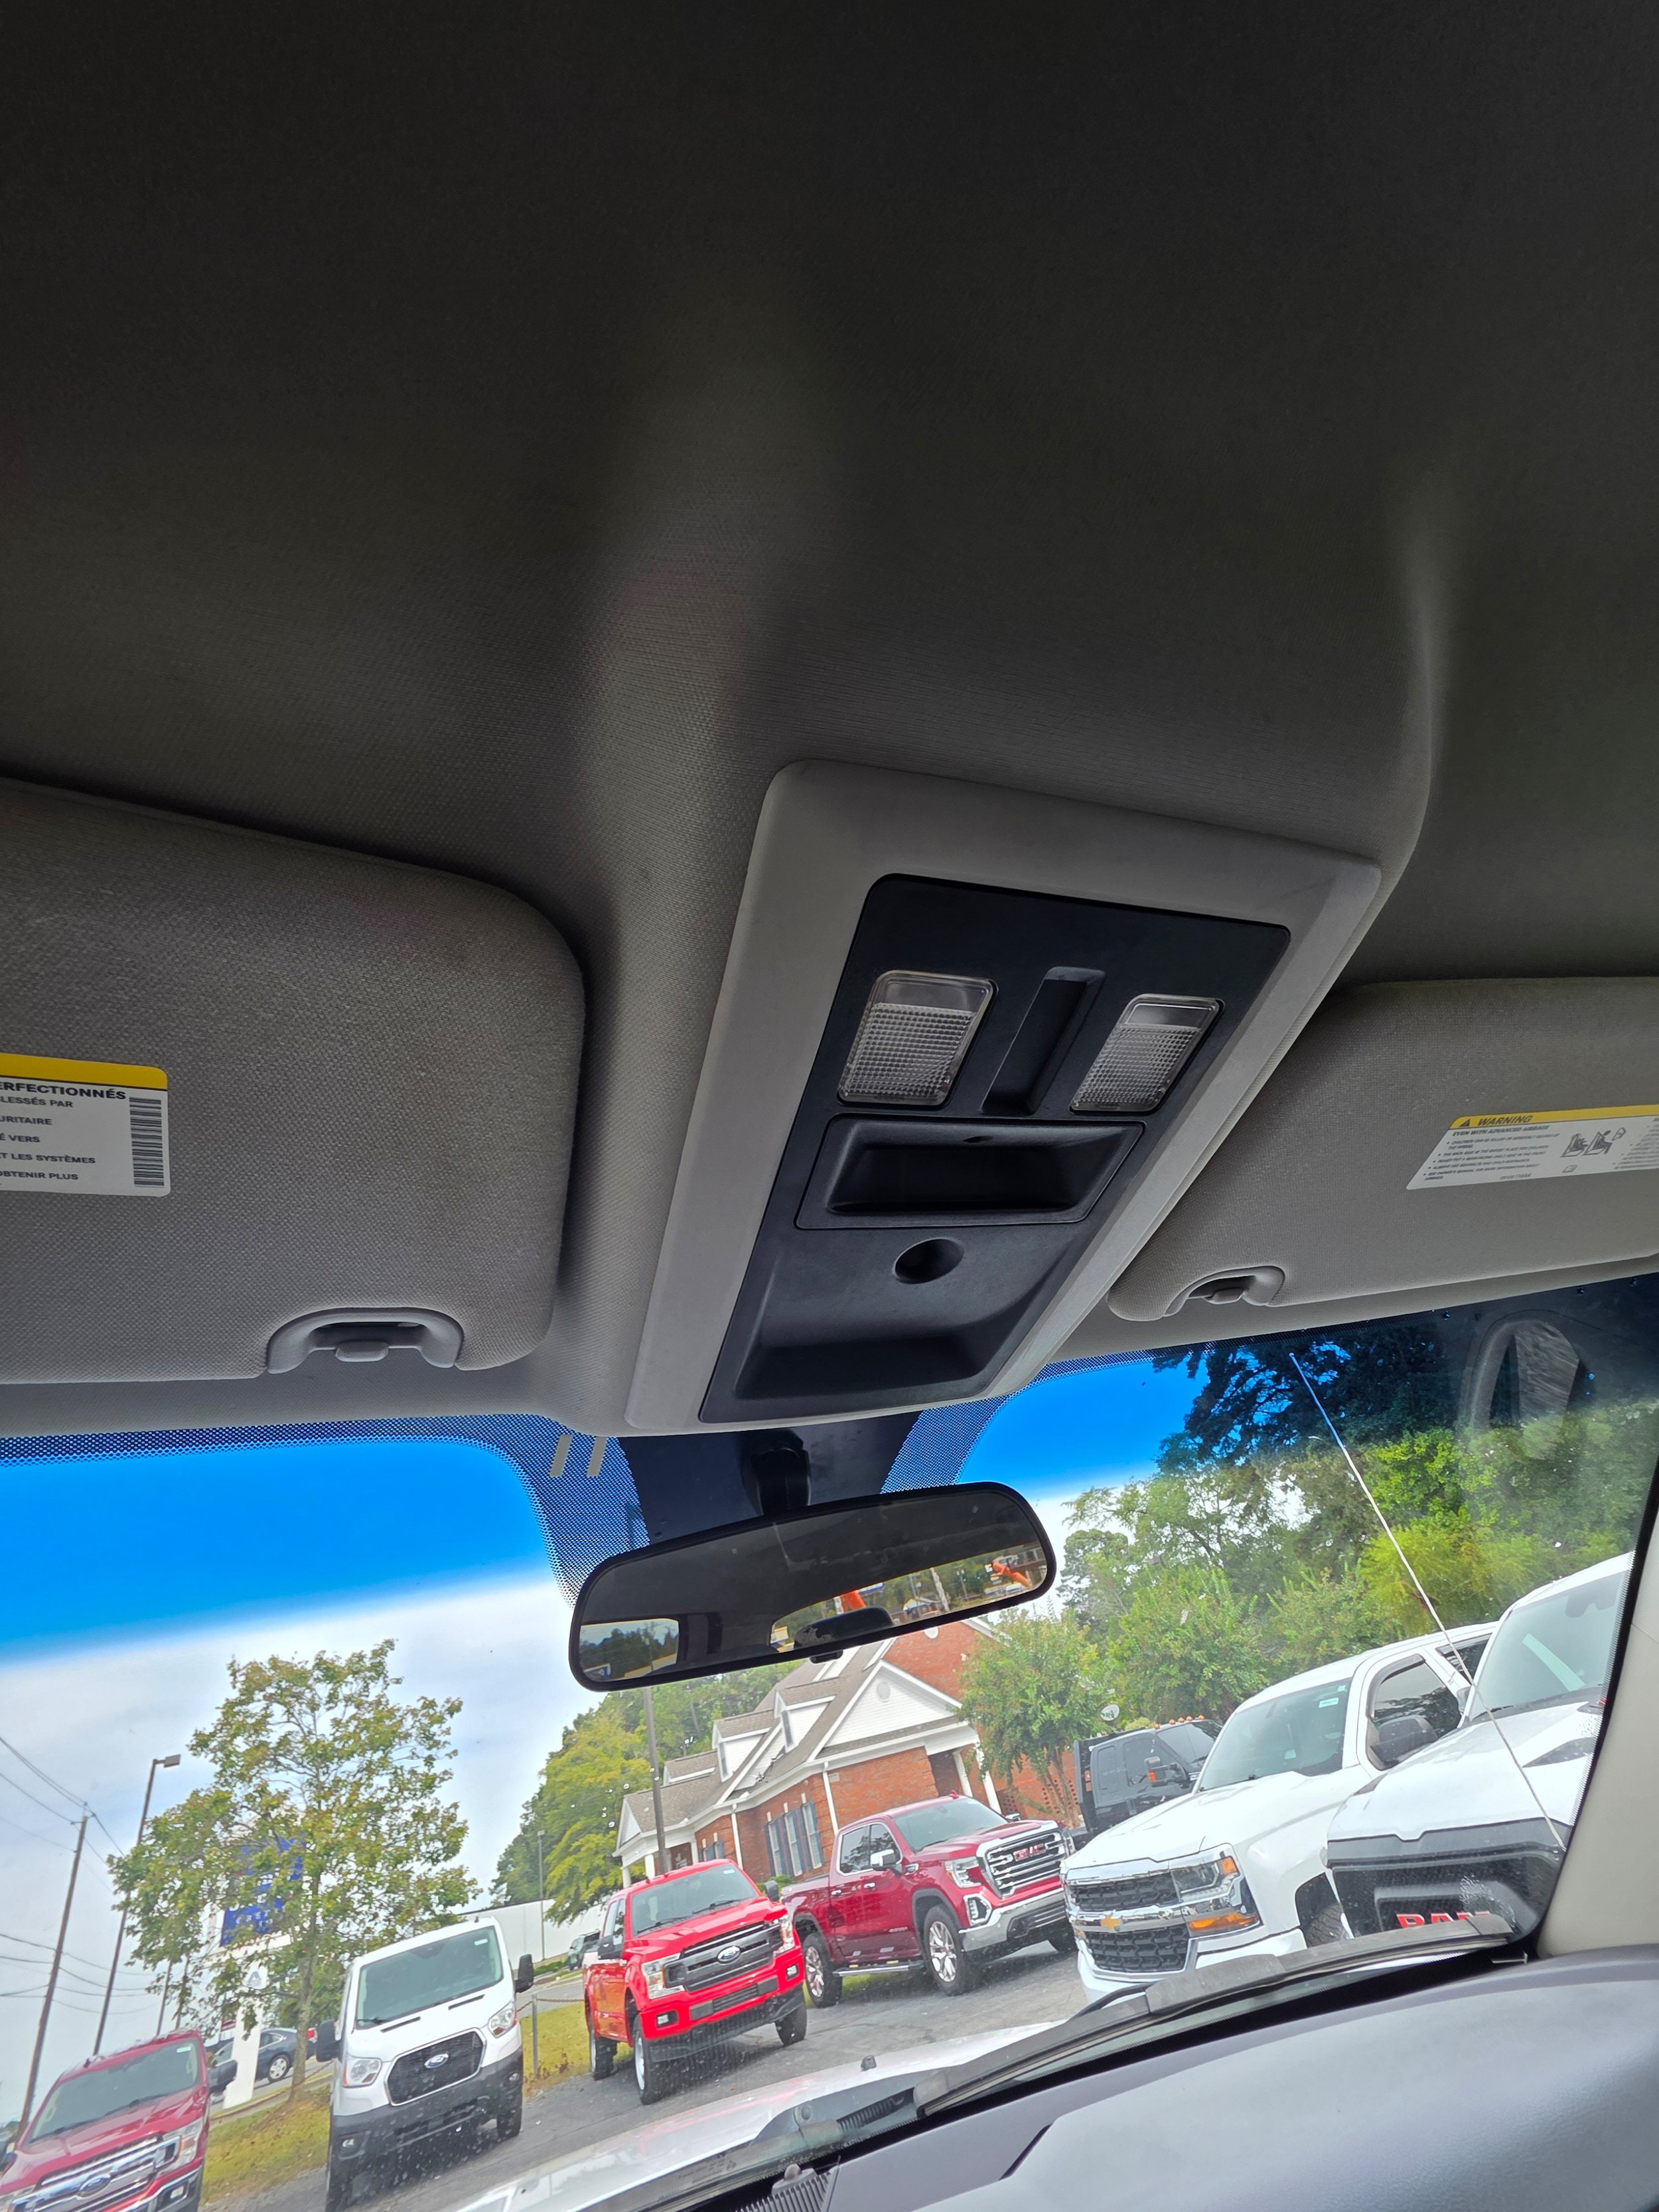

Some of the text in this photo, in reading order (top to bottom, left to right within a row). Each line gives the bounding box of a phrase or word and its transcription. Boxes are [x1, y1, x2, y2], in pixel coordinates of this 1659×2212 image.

[1478, 1116, 1533, 1126] WARNING
[8, 1134, 40, 1143] VERS
[36, 1154, 96, 1163] SYSTÈMES
